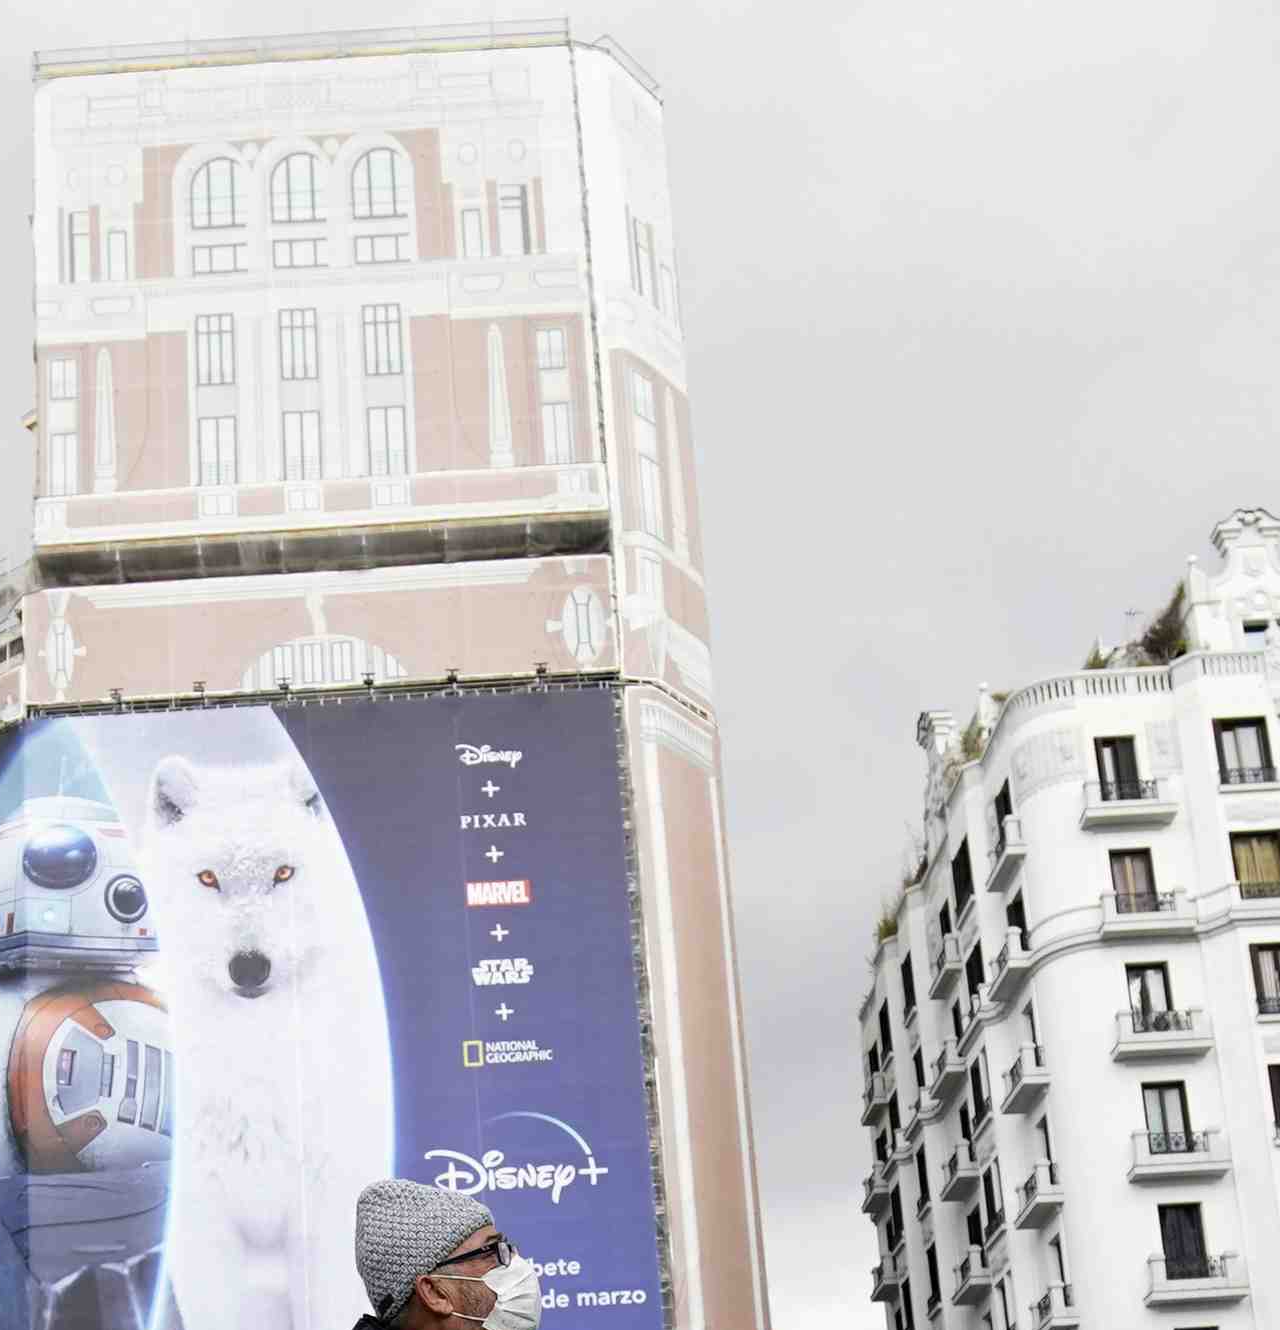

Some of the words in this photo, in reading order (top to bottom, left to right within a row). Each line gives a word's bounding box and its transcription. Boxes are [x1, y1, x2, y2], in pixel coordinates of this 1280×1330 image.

[455, 744, 523, 768] Disney
[460, 812, 527, 829] PIXAR
[466, 880, 530, 905] MARVEL
[477, 958, 530, 972] STAR
[472, 967, 533, 986] WARS
[485, 1040, 540, 1052] NATIONAL
[485, 1049, 553, 1064] GEOGRAPHIC
[424, 1148, 609, 1204] Disney+
[541, 1289, 569, 1309] de
[577, 1289, 647, 1306] marzo
